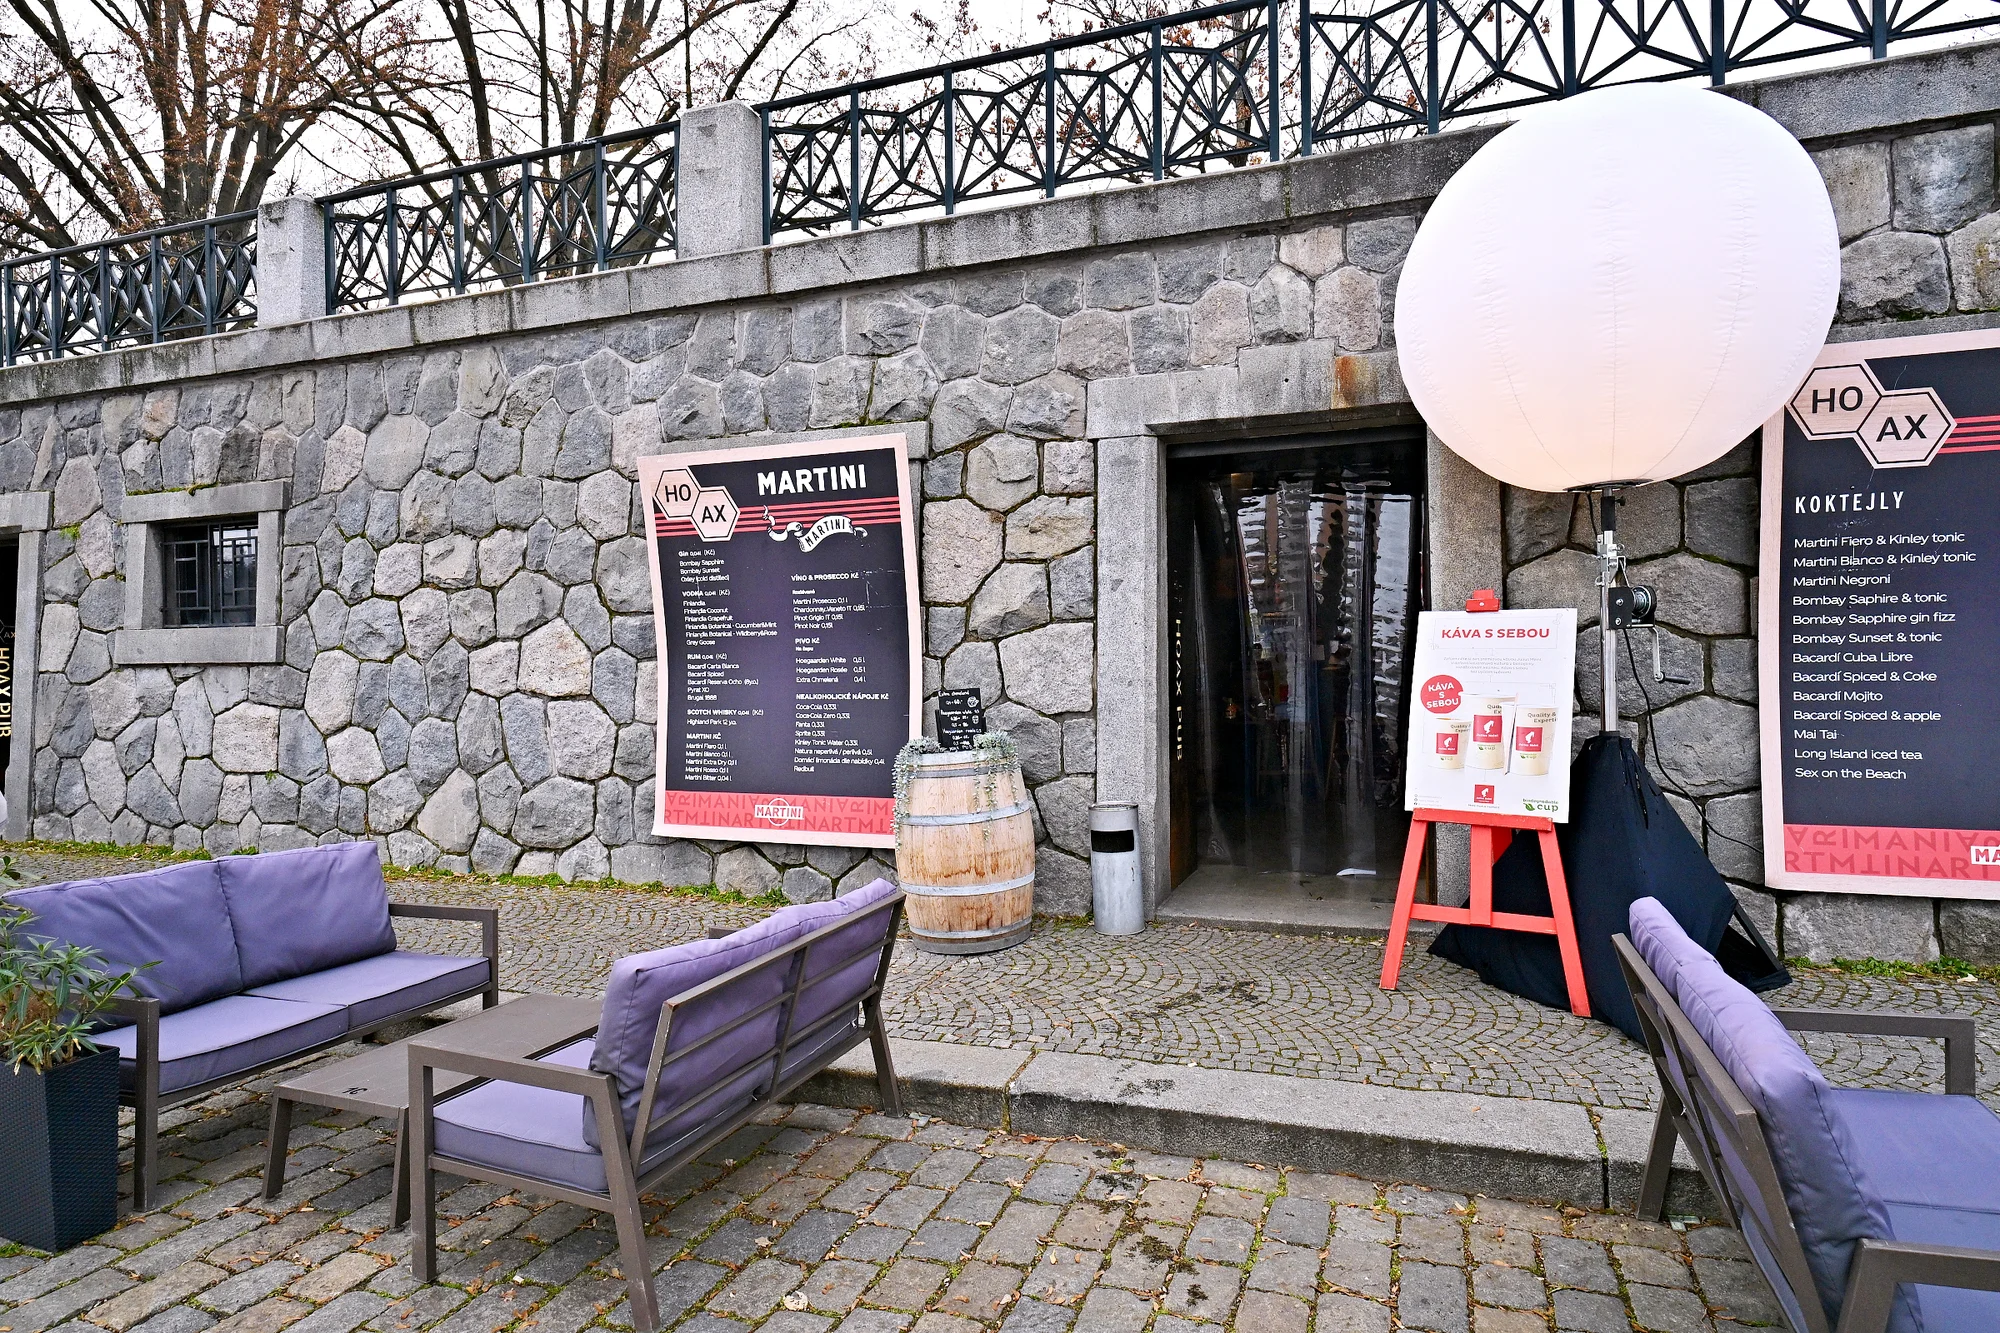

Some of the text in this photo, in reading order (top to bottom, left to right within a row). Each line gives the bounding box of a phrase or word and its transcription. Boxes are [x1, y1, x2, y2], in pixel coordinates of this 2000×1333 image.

[1812, 386, 1863, 413] HO
[1876, 414, 1928, 442] AX
[758, 464, 867, 496] MARTINI
[665, 484, 691, 503] HO
[1795, 492, 1904, 513] KOKTEJLY
[701, 505, 727, 523] AX
[806, 518, 846, 547] MARTINI
[1794, 532, 1965, 548] Martini Fiero & Kinley tonic
[1793, 552, 1977, 567] Martini Bianco & Kinley tonic
[1793, 574, 1891, 586] Martini Negroni
[1792, 592, 1948, 607] Bombay Saphire & tonic
[1792, 612, 1956, 626] Bombay Sapphire gin fizz
[1442, 627, 1549, 638] KÁVA S SEBOU
[1792, 632, 1942, 645] Bombay Sunset & tonic
[1792, 652, 1913, 662] Bacardí Cuba Libre
[1792, 671, 1937, 683] Bacardí Spiced & Coke
[1428, 682, 1454, 692] KÁVA
[1793, 691, 1883, 702] Bacardí Mojito
[1426, 698, 1458, 708] SEBOU
[1793, 710, 1942, 722] Bacardí Spiced & apple
[1794, 730, 1837, 739] Mai Tai
[1794, 749, 1923, 760] Long Island iced tea
[1795, 768, 1907, 779] Sex on the Beach
[756, 806, 802, 818] MARTINI
